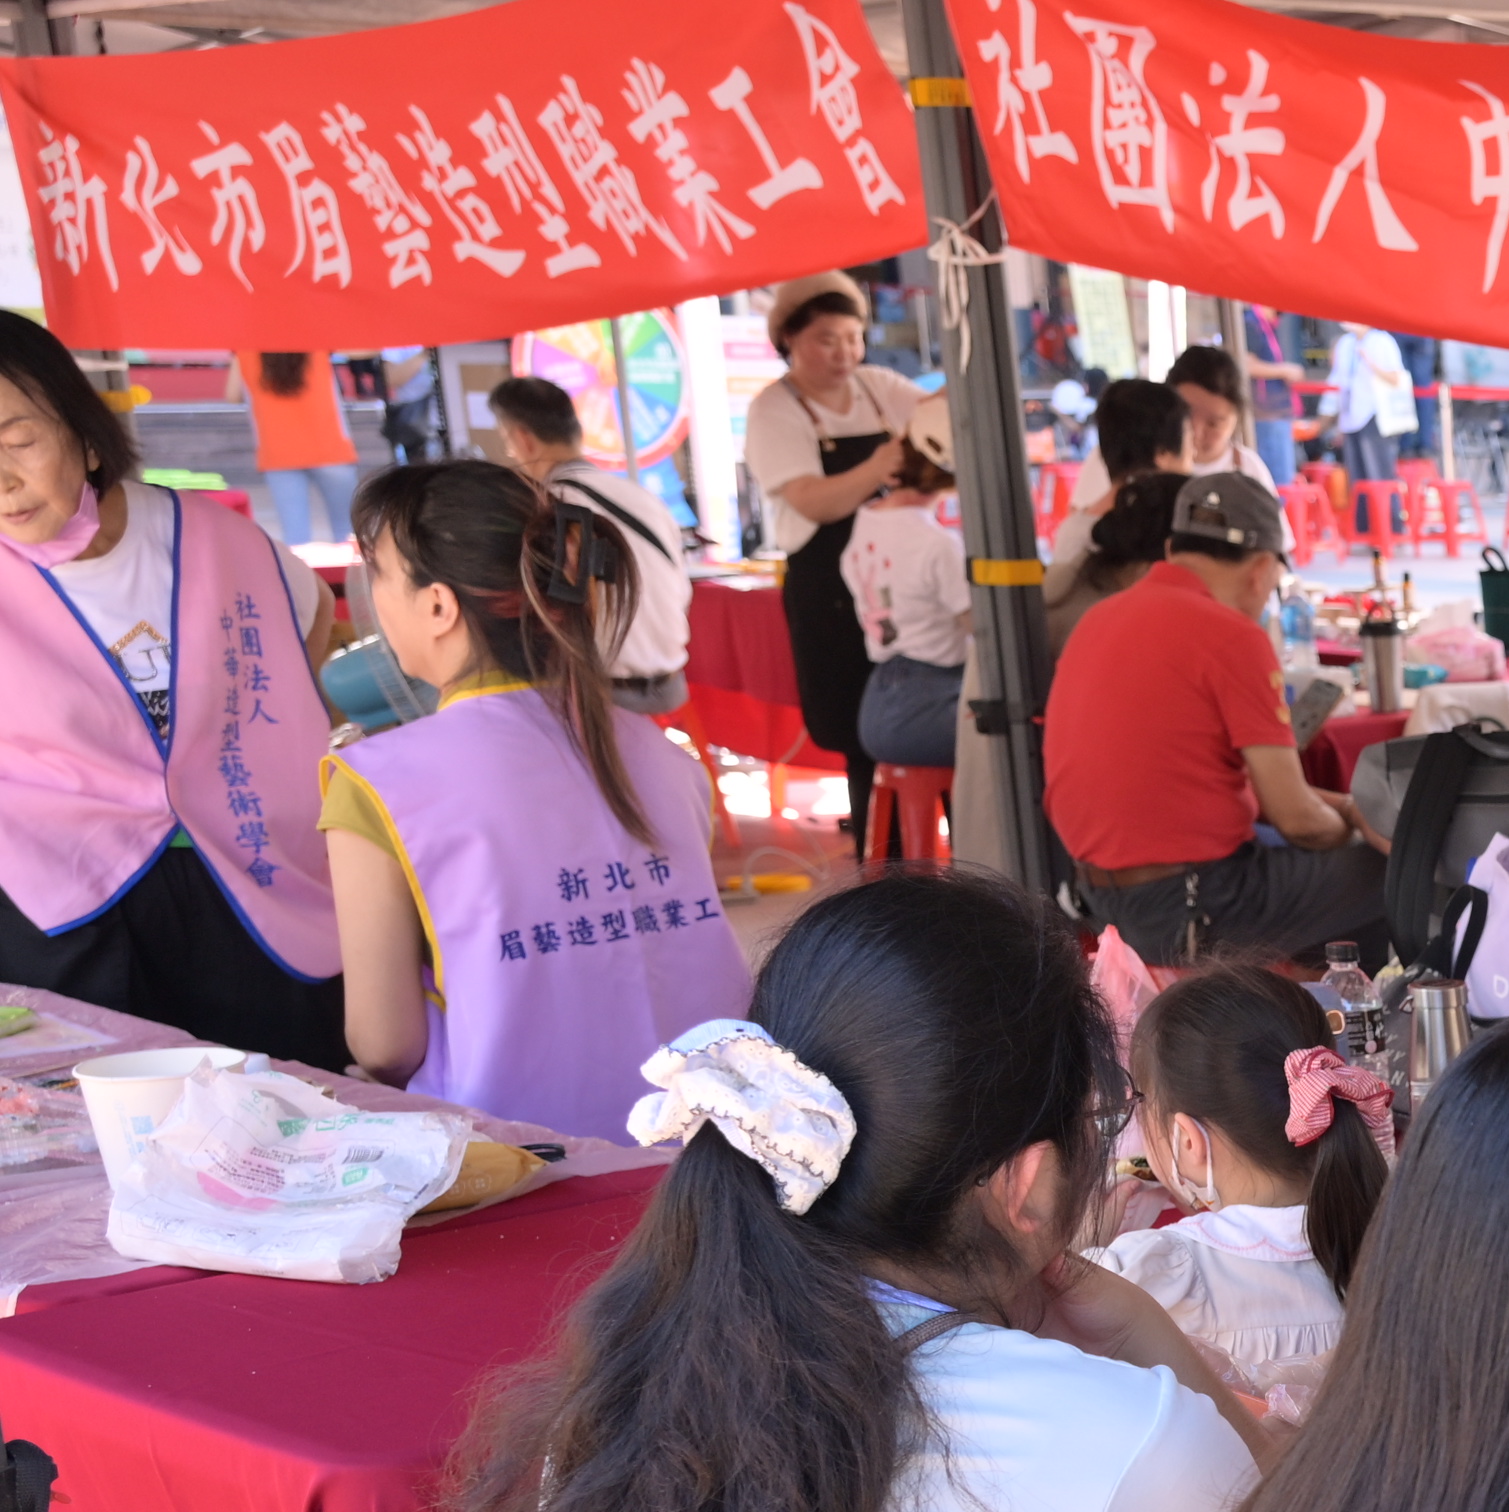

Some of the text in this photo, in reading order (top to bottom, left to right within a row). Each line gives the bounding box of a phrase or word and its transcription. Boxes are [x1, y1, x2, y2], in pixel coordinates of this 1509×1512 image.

[38, 2, 906, 292] 新北市眉藝造型職業工會
[234, 592, 280, 725] 社團法人
[218, 608, 282, 889] 中華造型藝術學會
[499, 897, 721, 963] 眉藝造型職業工
[556, 853, 672, 902] 新北市
